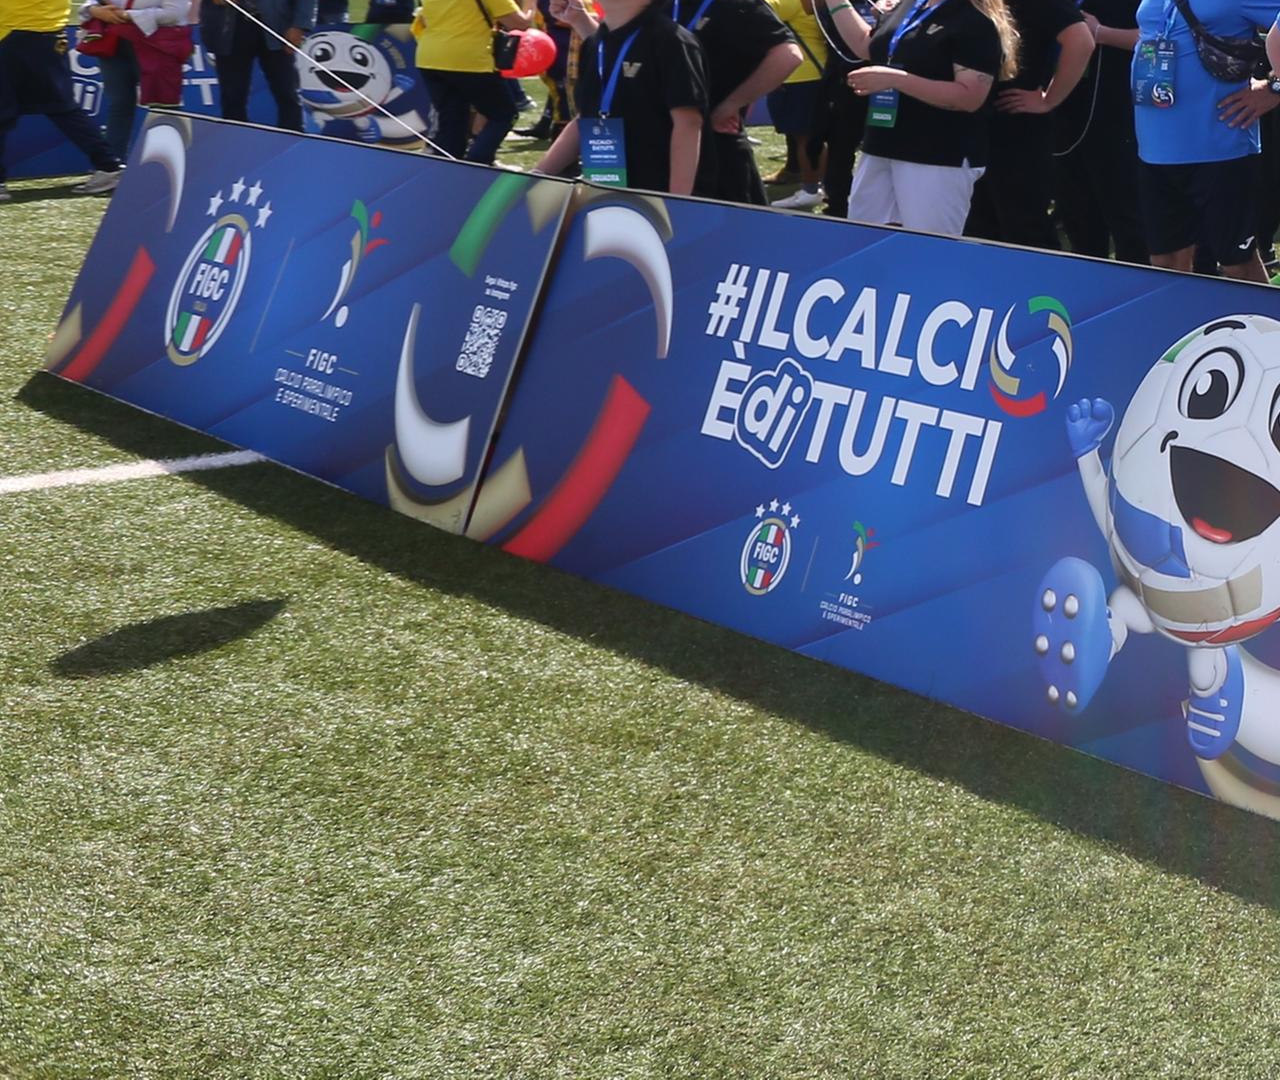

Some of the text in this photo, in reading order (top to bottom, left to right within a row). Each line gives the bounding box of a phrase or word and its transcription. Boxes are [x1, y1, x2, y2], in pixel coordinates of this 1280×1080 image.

[189, 262, 229, 301] FIGC
[305, 348, 338, 374] FIGC
[753, 542, 779, 564] FIGC
[838, 592, 860, 607] FIGC
